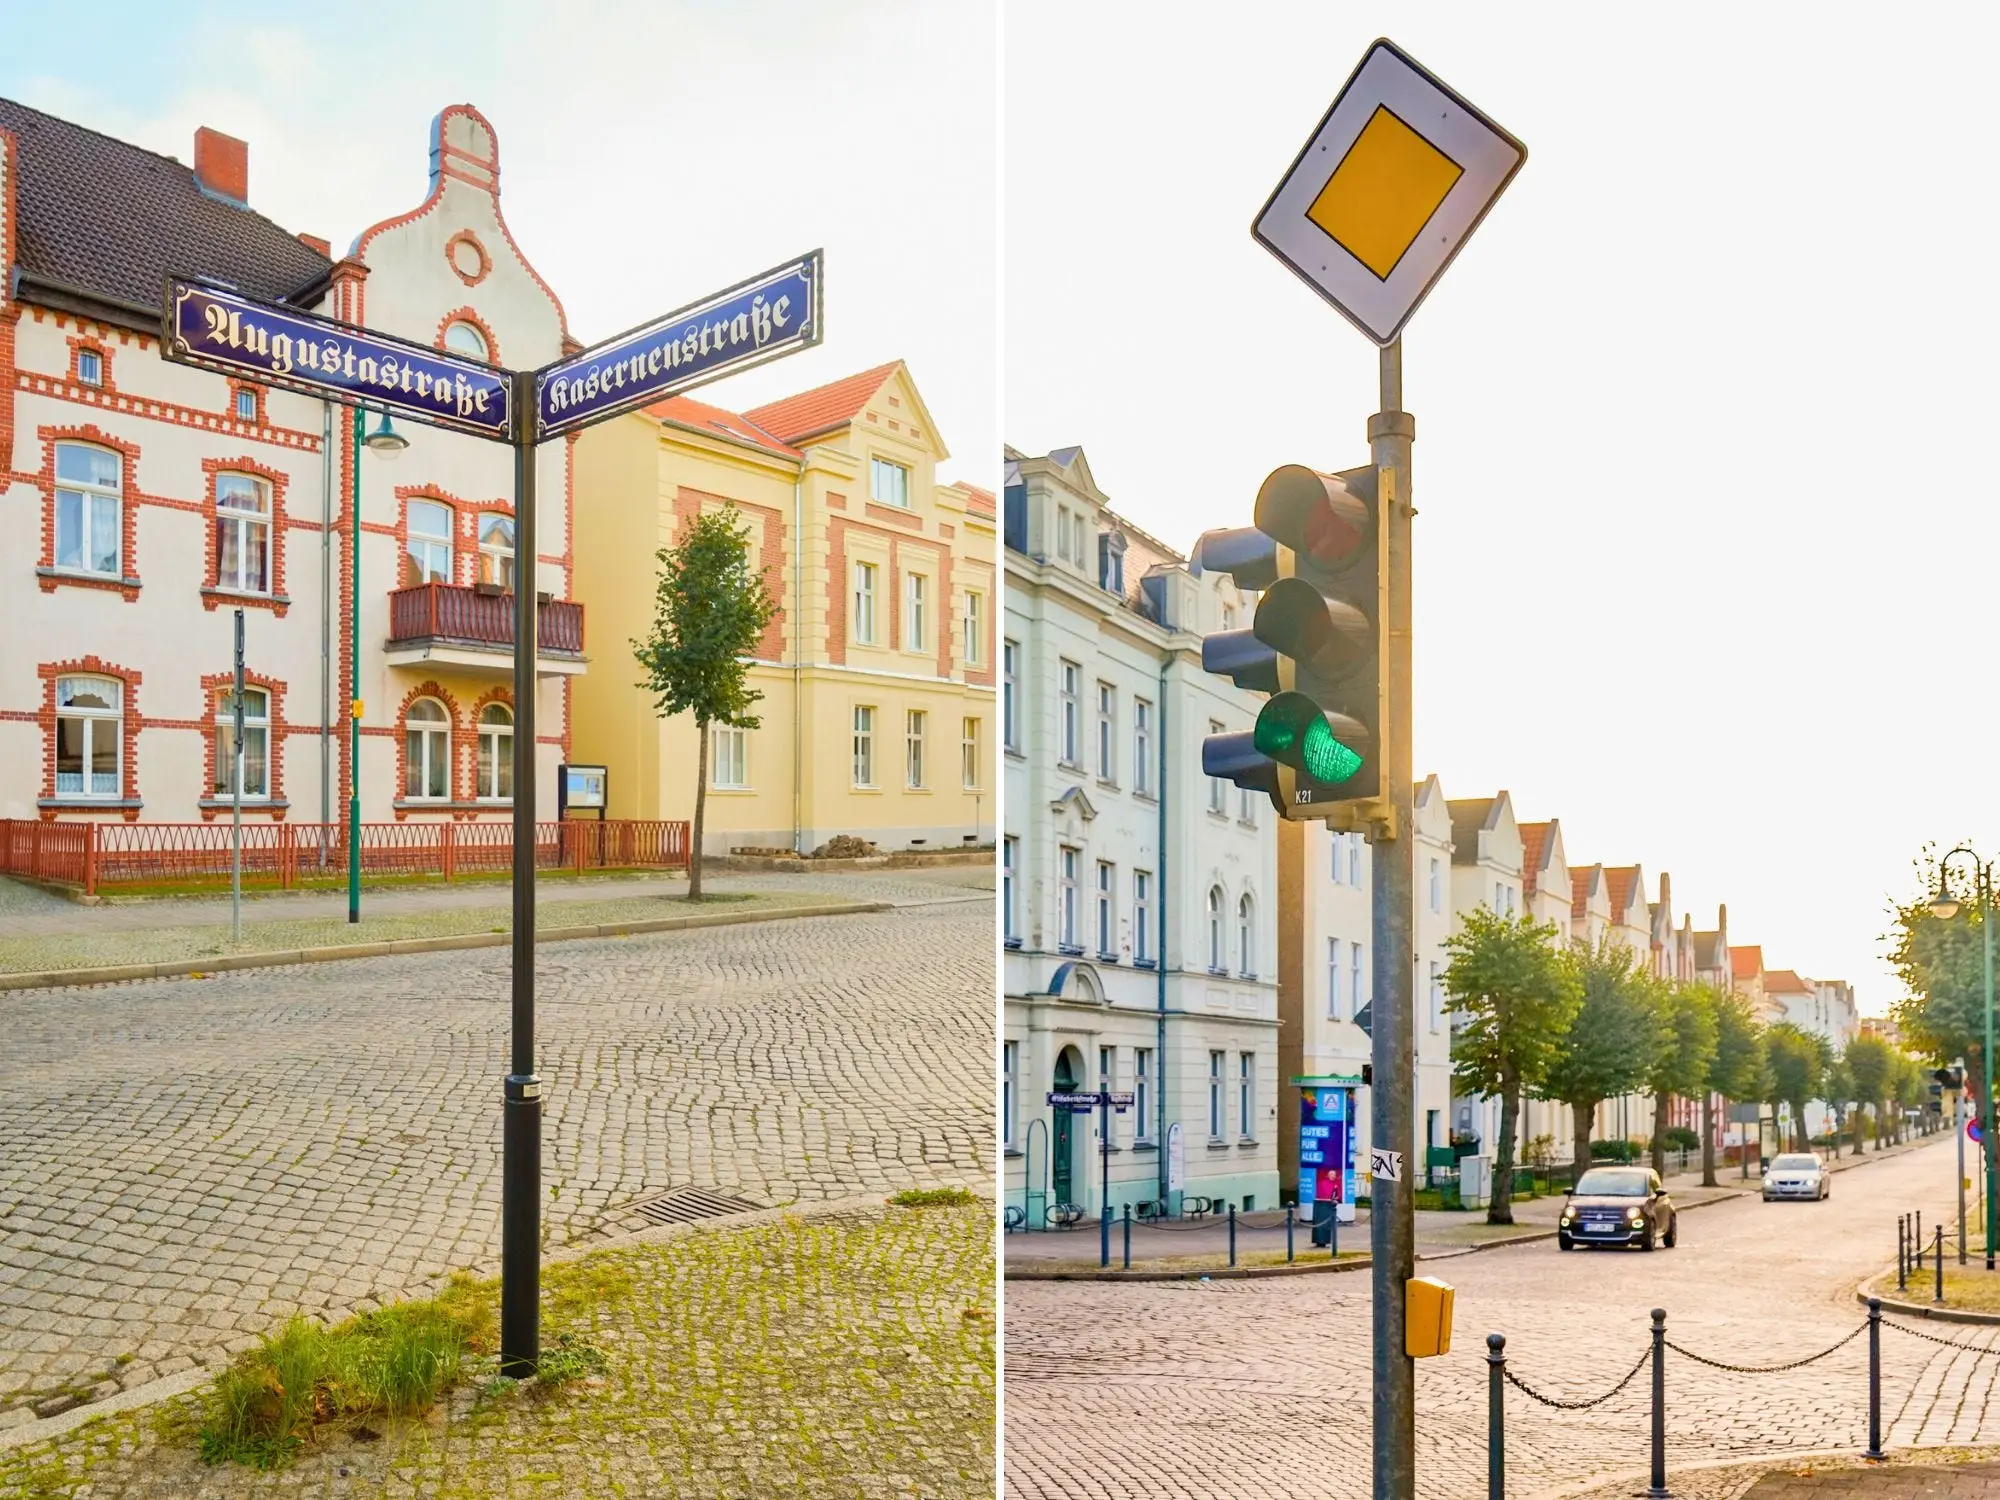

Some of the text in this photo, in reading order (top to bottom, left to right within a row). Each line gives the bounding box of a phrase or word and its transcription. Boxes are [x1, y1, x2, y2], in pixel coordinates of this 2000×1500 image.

[204, 303, 491, 417] Augustastraße
[549, 293, 792, 415] Kasernenstraße
[1295, 790, 1311, 804] K21
[1302, 1127, 1328, 1137] GUTES
